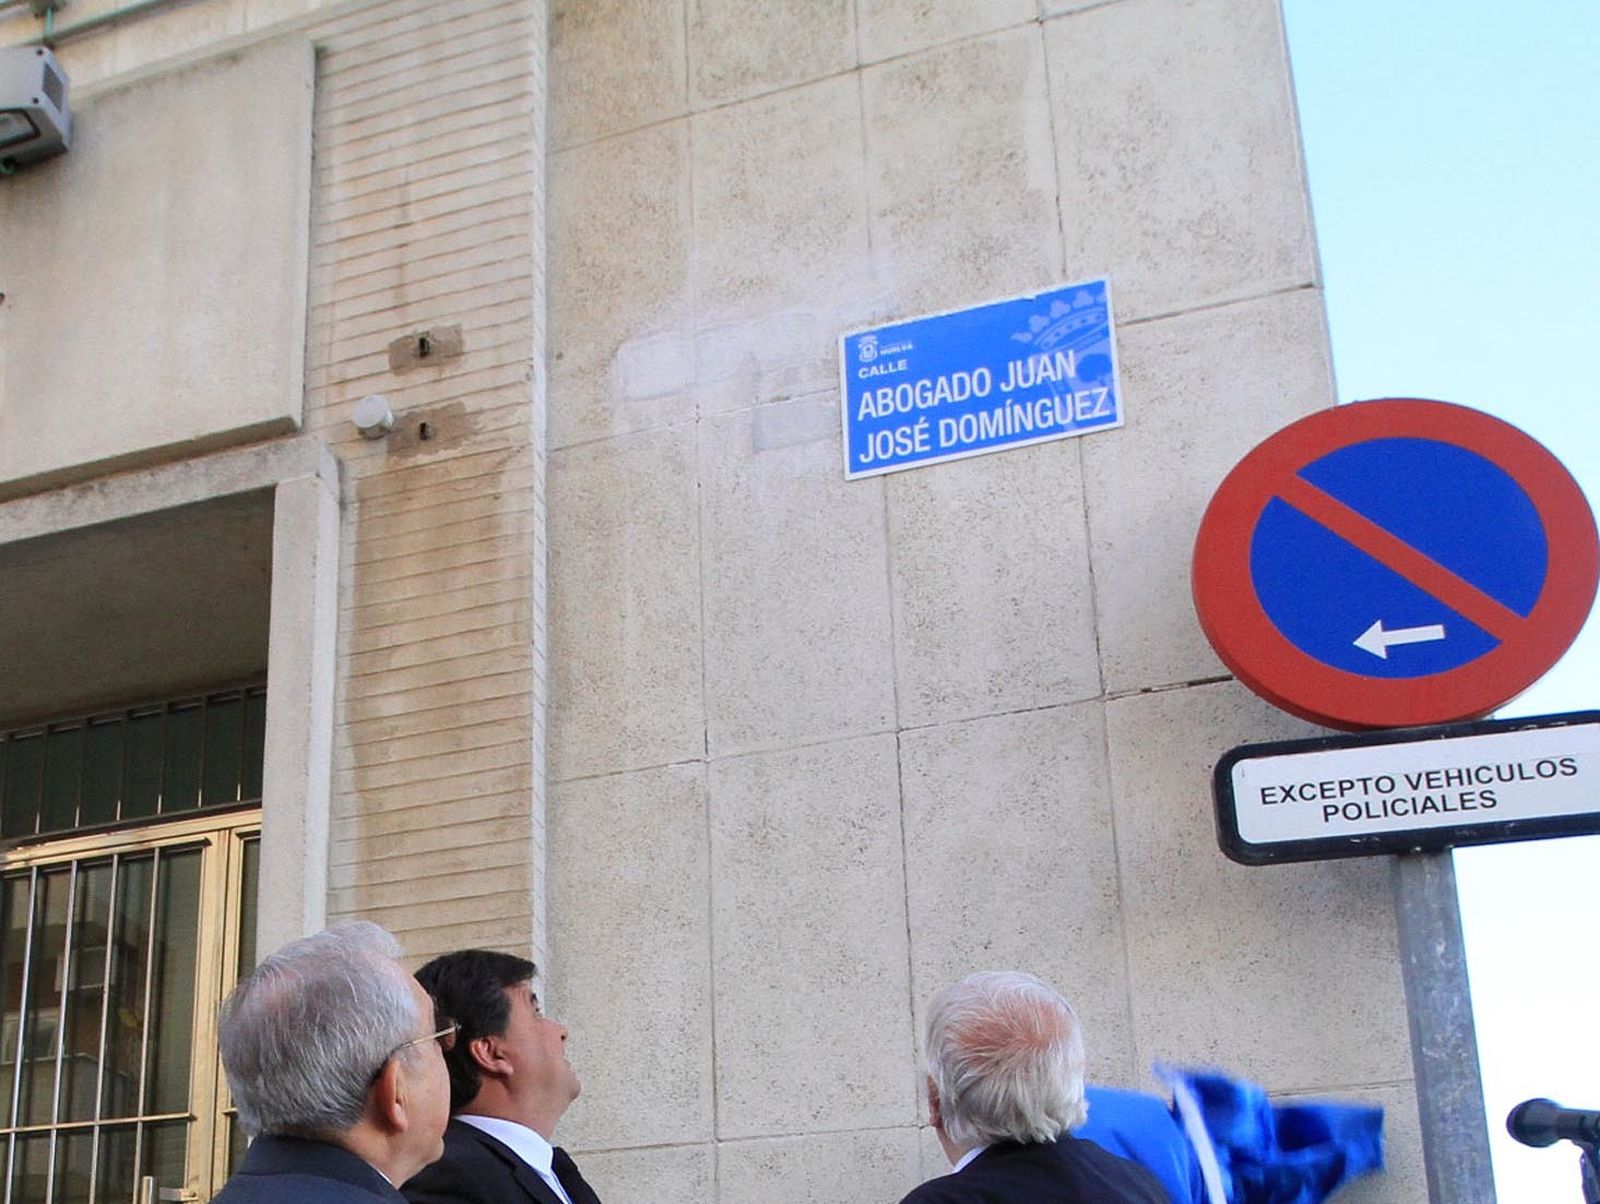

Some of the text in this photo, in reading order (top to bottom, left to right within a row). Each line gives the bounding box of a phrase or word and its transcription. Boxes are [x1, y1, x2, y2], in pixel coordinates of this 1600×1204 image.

[857, 350, 1077, 421] ABOGADO JUAN
[858, 359, 907, 379] CALLE
[859, 386, 1110, 463] JOSÉ DOMÍNGUEZ
[1260, 757, 1578, 805] EXCEPTO VEHICULOS
[1323, 790, 1497, 823] POLICIALES
